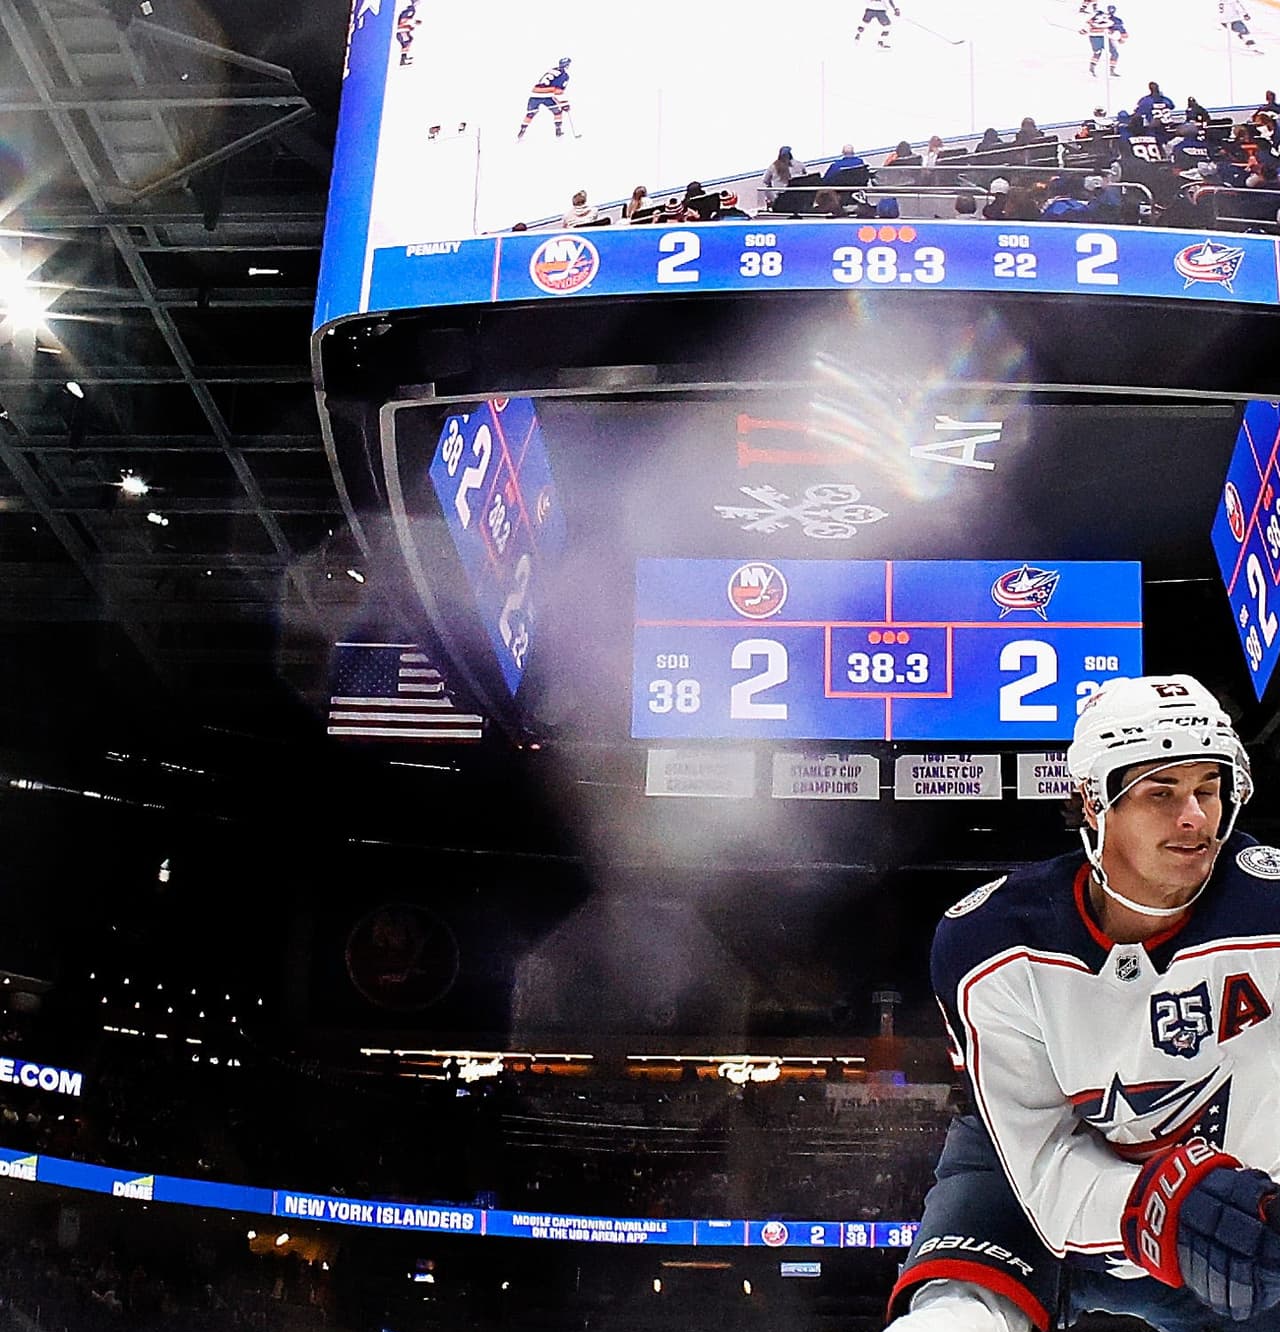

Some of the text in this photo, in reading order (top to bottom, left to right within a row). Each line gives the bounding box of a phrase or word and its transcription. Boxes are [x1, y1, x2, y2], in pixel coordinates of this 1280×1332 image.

[406, 240, 461, 256] PENALTY
[745, 234, 776, 247] SOG
[998, 235, 1030, 249] SOG
[657, 231, 700, 283] 2
[739, 251, 783, 276] 38
[832, 246, 945, 284] 38.3
[994, 252, 1036, 278] 22
[1076, 233, 1119, 285] 2
[1247, 553, 1278, 648] 2
[848, 654, 929, 683] 38.3
[1084, 656, 1118, 671] SOG
[730, 639, 788, 720] 2
[1000, 640, 1057, 721] 2
[648, 680, 701, 714] 38
[1076, 681, 1104, 715] 2
[912, 766, 984, 778] STANLEY CUP
[1034, 766, 1071, 778] STANL
[915, 782, 981, 794] CHAMPIONS
[1038, 782, 1075, 794] CHAMP
[1156, 996, 1209, 1040] 25
[1219, 972, 1273, 1046] A
[112, 1182, 153, 1200] DIME
[285, 1196, 475, 1230] NEW YORK ISLANDERS
[512, 1215, 667, 1233] MOBILE CAPTIONING AVAILABLE
[532, 1226, 548, 1238] ON
[549, 1227, 568, 1239] THE
[590, 1230, 625, 1242] ARENA
[627, 1231, 648, 1243] APP
[811, 1226, 825, 1244] 2
[846, 1232, 867, 1246] 38
[888, 1229, 914, 1246] 38
[914, 1237, 1034, 1277] BAUER
